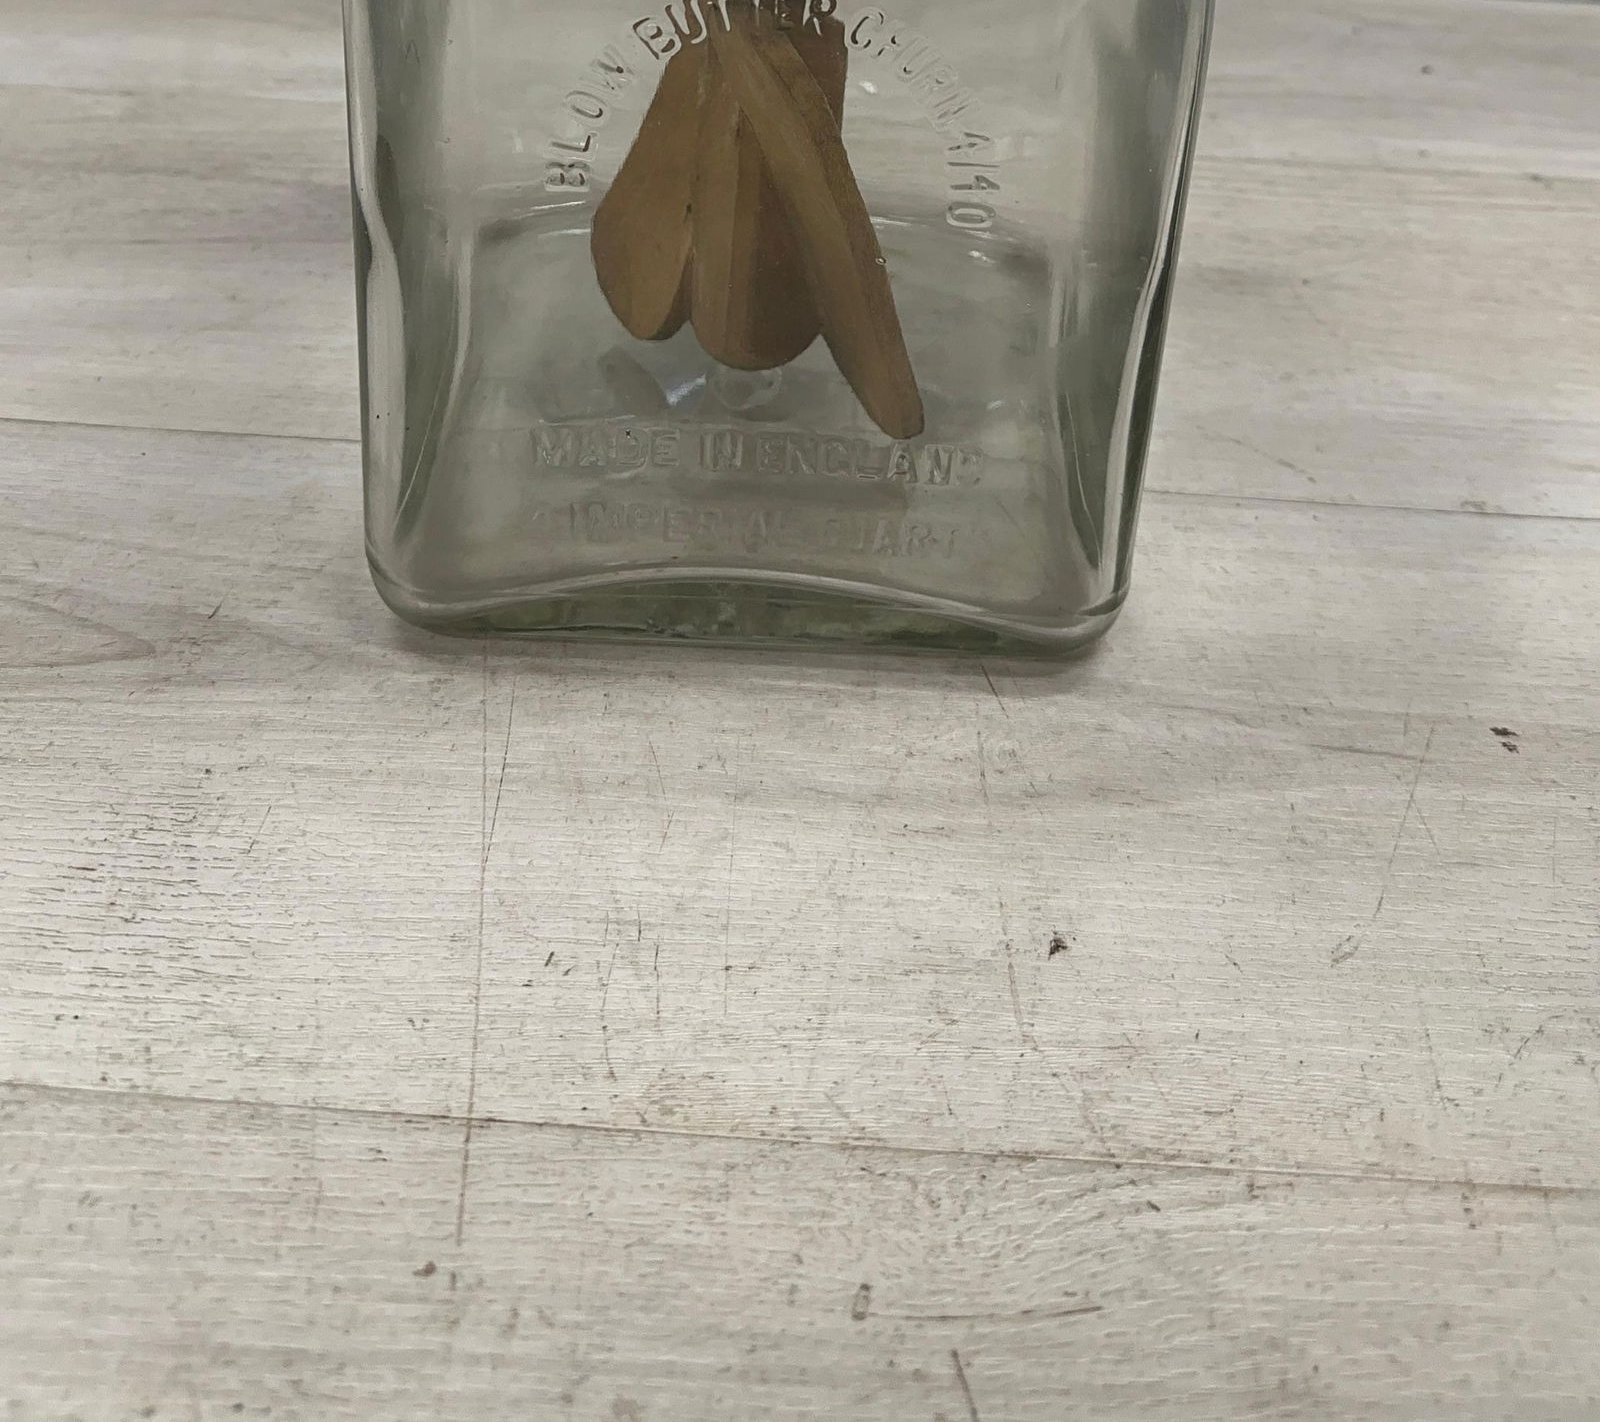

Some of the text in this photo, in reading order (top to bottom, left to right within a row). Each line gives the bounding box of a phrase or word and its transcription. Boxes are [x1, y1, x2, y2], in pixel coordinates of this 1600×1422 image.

[544, 44, 636, 192] BLOW
[846, 6, 985, 132] CHURN
[529, 426, 984, 486] MADE IN ENGLAND
